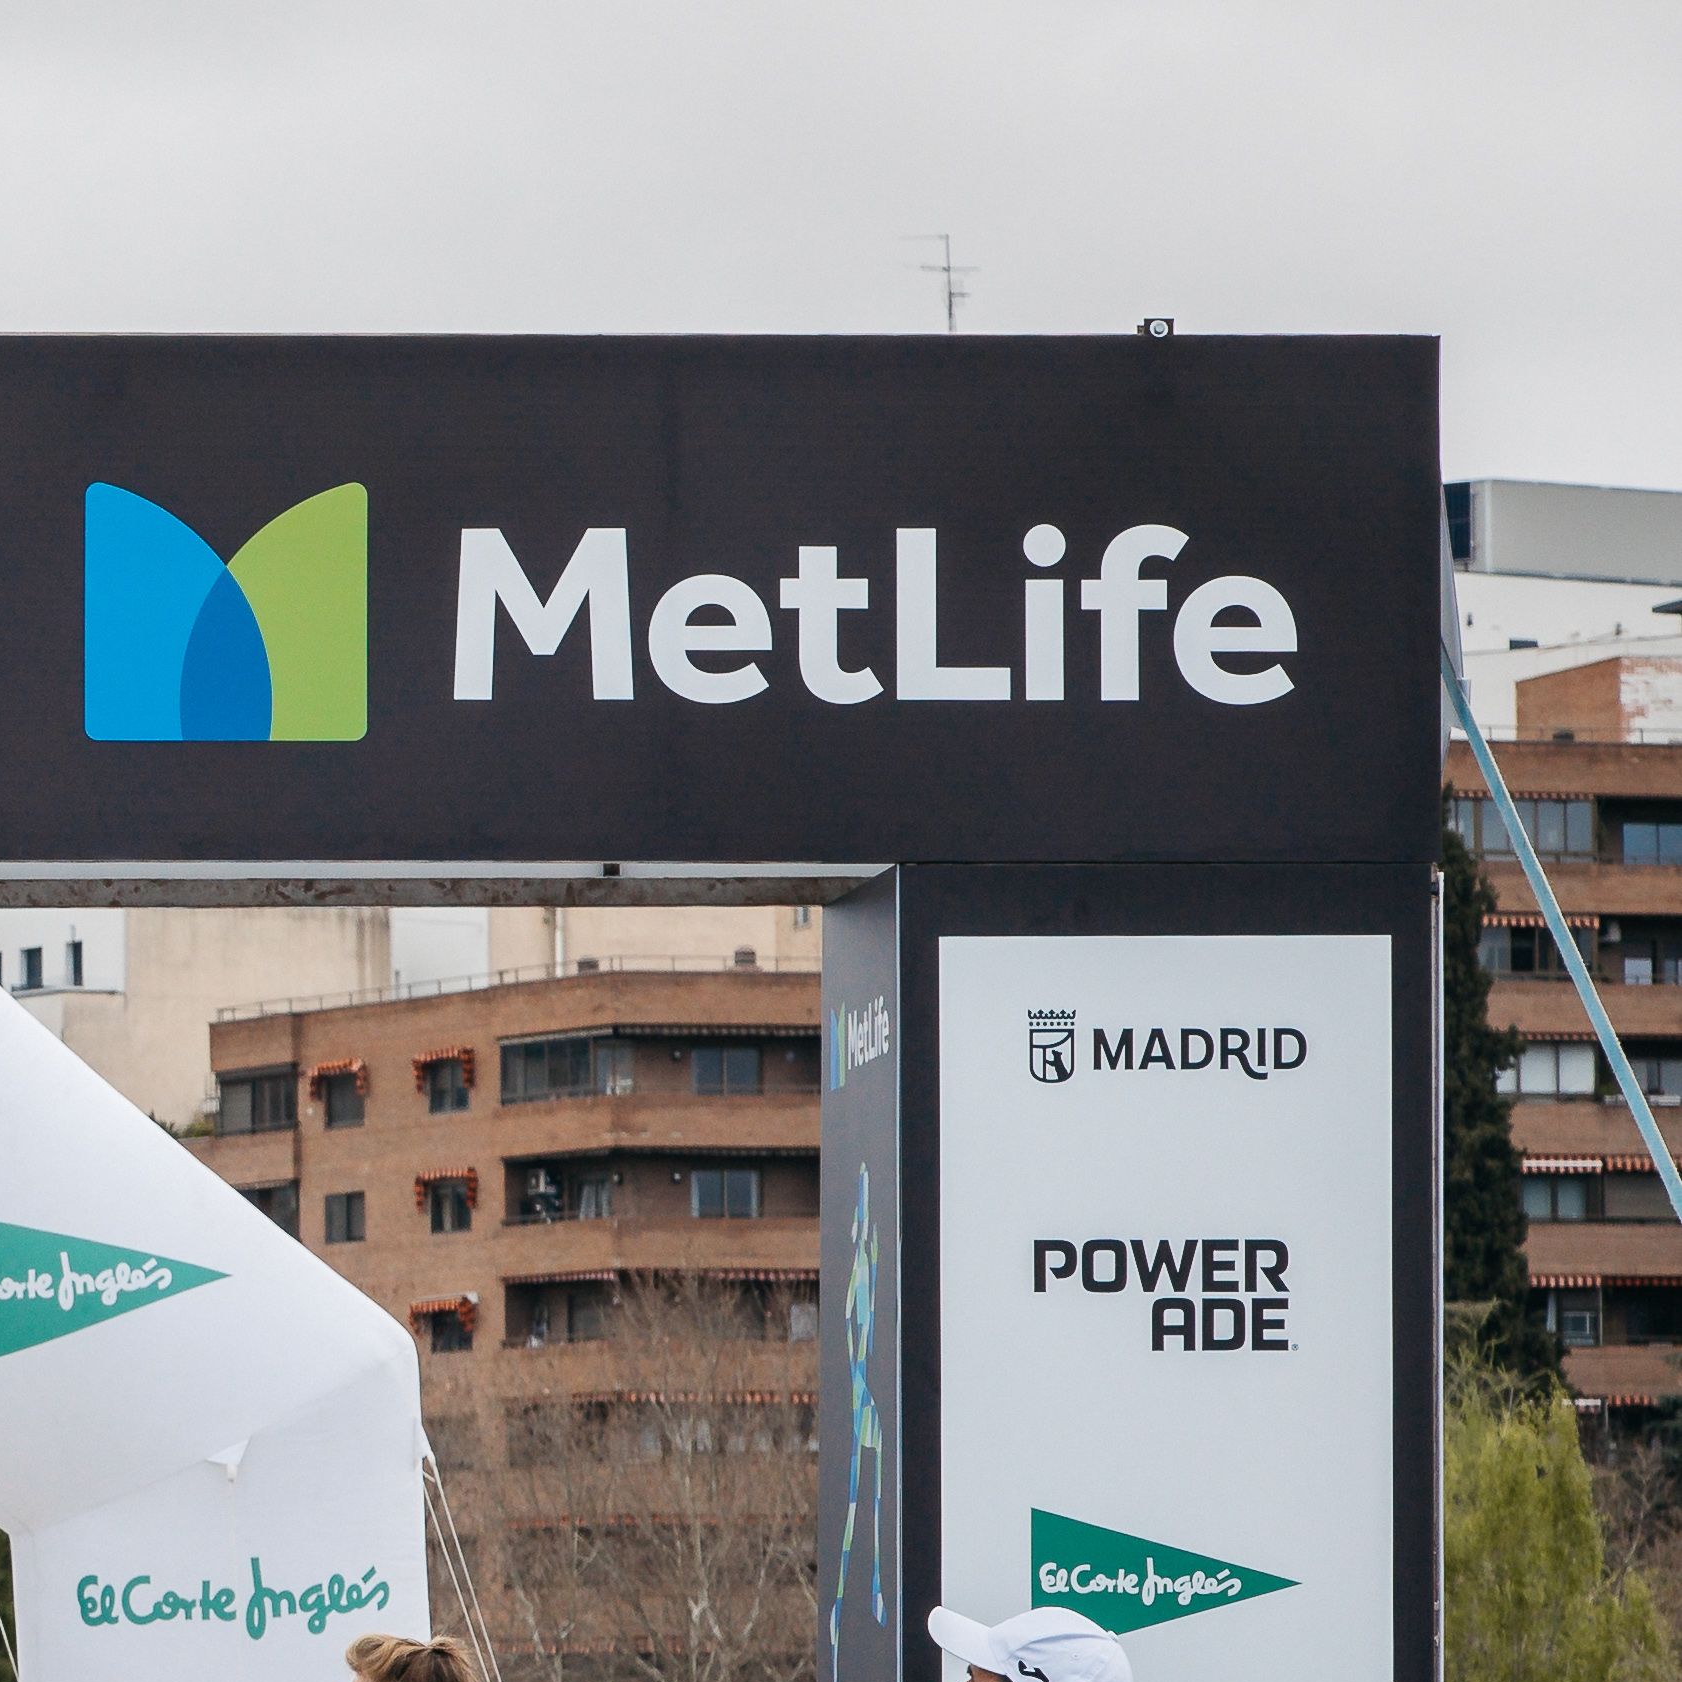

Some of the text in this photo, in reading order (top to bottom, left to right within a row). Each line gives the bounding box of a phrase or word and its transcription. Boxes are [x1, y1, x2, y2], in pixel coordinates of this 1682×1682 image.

[453, 523, 1299, 705] MetLife
[847, 996, 890, 1071] MetLife
[1092, 1027, 1307, 1080] MADRID
[59, 1251, 173, 1311] Inglés
[1033, 1239, 1290, 1293] POWER
[1151, 1298, 1289, 1351] ADE
[76, 1556, 391, 1641] El Corte Inglés
[1040, 1556, 1243, 1607] El Corte Inglés
